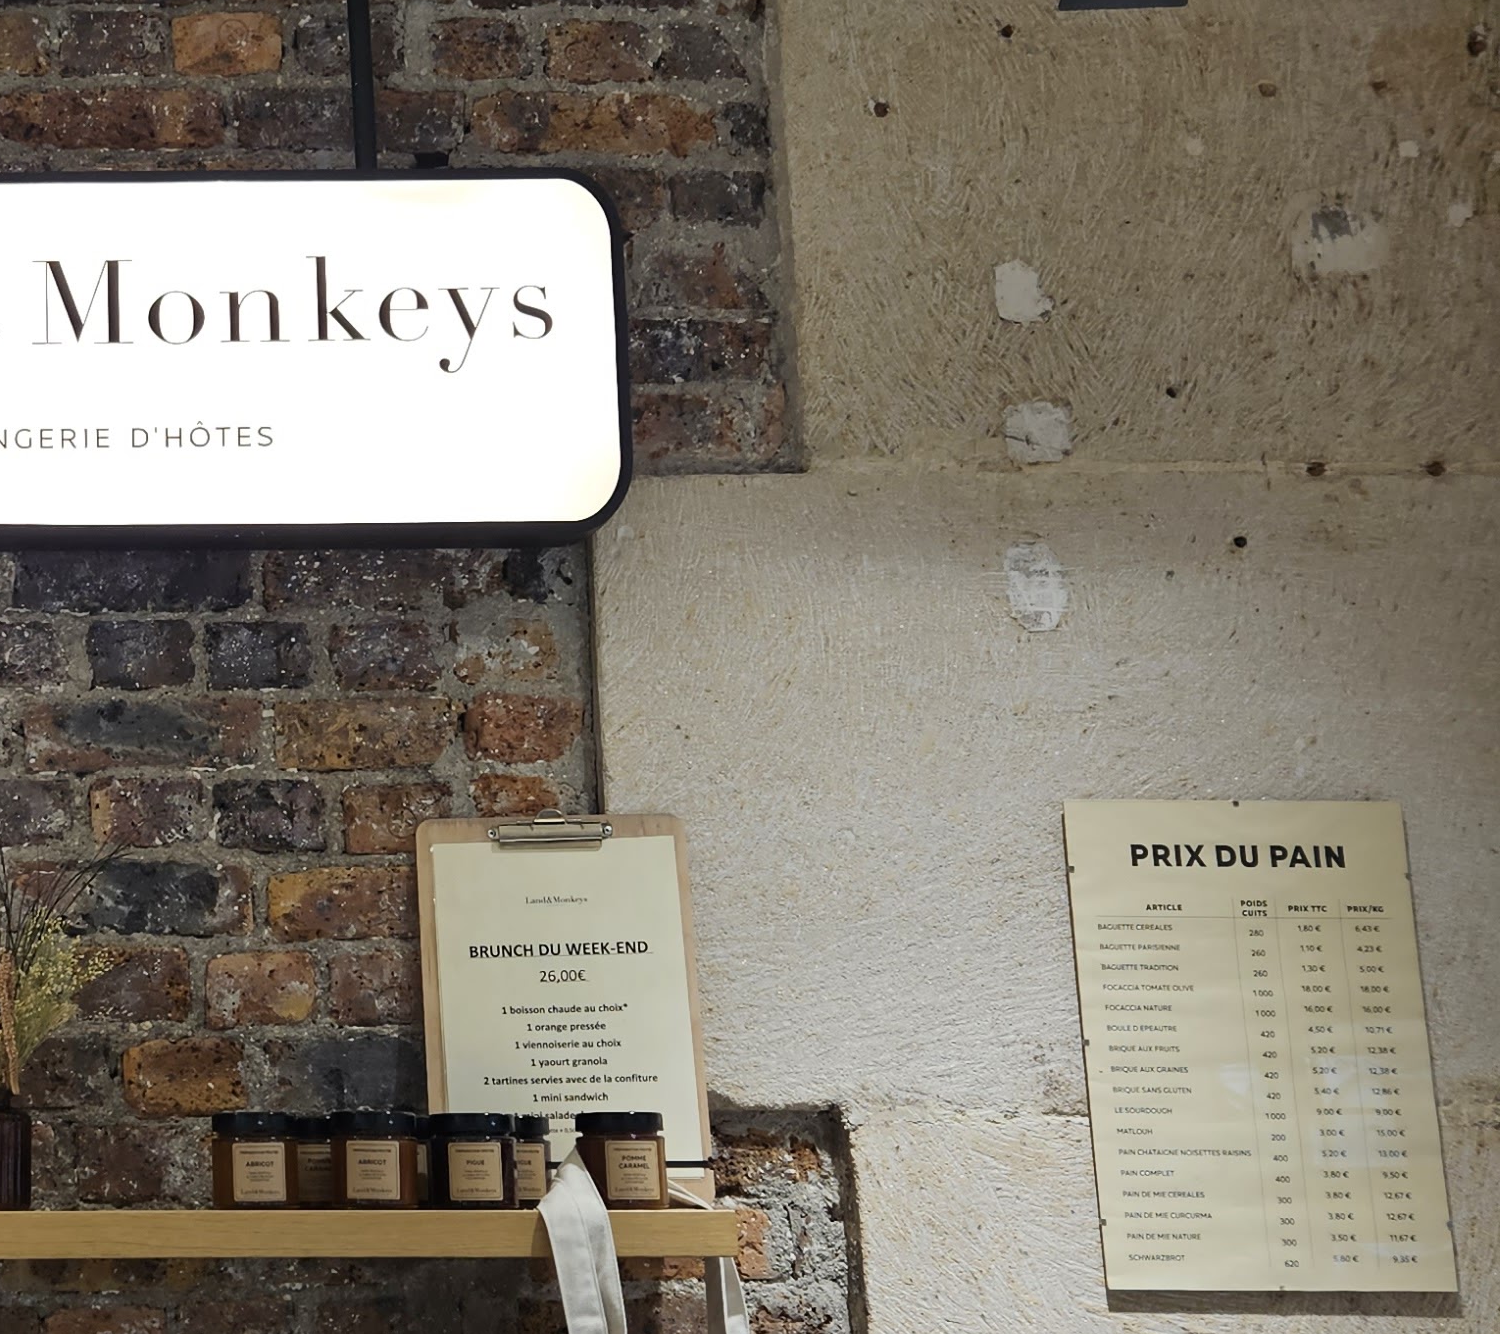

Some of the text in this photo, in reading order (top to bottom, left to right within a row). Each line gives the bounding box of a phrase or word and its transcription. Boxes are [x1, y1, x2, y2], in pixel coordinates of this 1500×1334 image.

[131, 420, 274, 449] D'HÔTES
[1130, 843, 1346, 869] PRIX DU PAIN
[1145, 903, 1183, 911] ARTICLE
[1240, 899, 1268, 908] POIDS
[1241, 909, 1268, 917] CUITS
[1287, 904, 1327, 913] PRIX TTC
[1346, 904, 1384, 914] PRIX/KG
[1097, 923, 1135, 931] BAGUETTE
[1248, 929, 1265, 937] 280
[469, 940, 649, 959] BRUNCH DU WEEK-END
[1099, 943, 1181, 951] BAGUETTE PARISIENNE
[1251, 949, 1266, 957] 260
[1100, 963, 1179, 972] BAGUETTE TRADITION
[539, 969, 587, 984] 26,00€
[1252, 969, 1269, 978] 260
[1102, 983, 1194, 992] FOCACCIA TOMATE OLIVE
[509, 1005, 546, 1015] boisson
[547, 1004, 582, 1014] chaude
[583, 1005, 596, 1013] au
[534, 1021, 607, 1033] orange pressée
[522, 1039, 580, 1050] viennoiserie
[596, 1038, 622, 1048] choix
[1108, 1044, 1136, 1053] BRIQUE
[1154, 1045, 1181, 1053] FRUITS
[538, 1056, 608, 1069] yaourt granola
[491, 1073, 658, 1086] tartines servies avec de la confiture
[540, 1091, 609, 1103] mini sandwich
[1116, 1127, 1153, 1136] MATLOUH
[1118, 1148, 1136, 1156] PAIN
[1179, 1148, 1222, 1157] NOISETTES
[1221, 1149, 1252, 1157] RAISINS
[357, 1158, 387, 1166] ABRICOT
[619, 1153, 647, 1162] POMME
[245, 1160, 274, 1168] ABRICOT
[617, 1161, 650, 1170] CARAMEL
[1128, 1253, 1185, 1262] SCHWARZBROT
